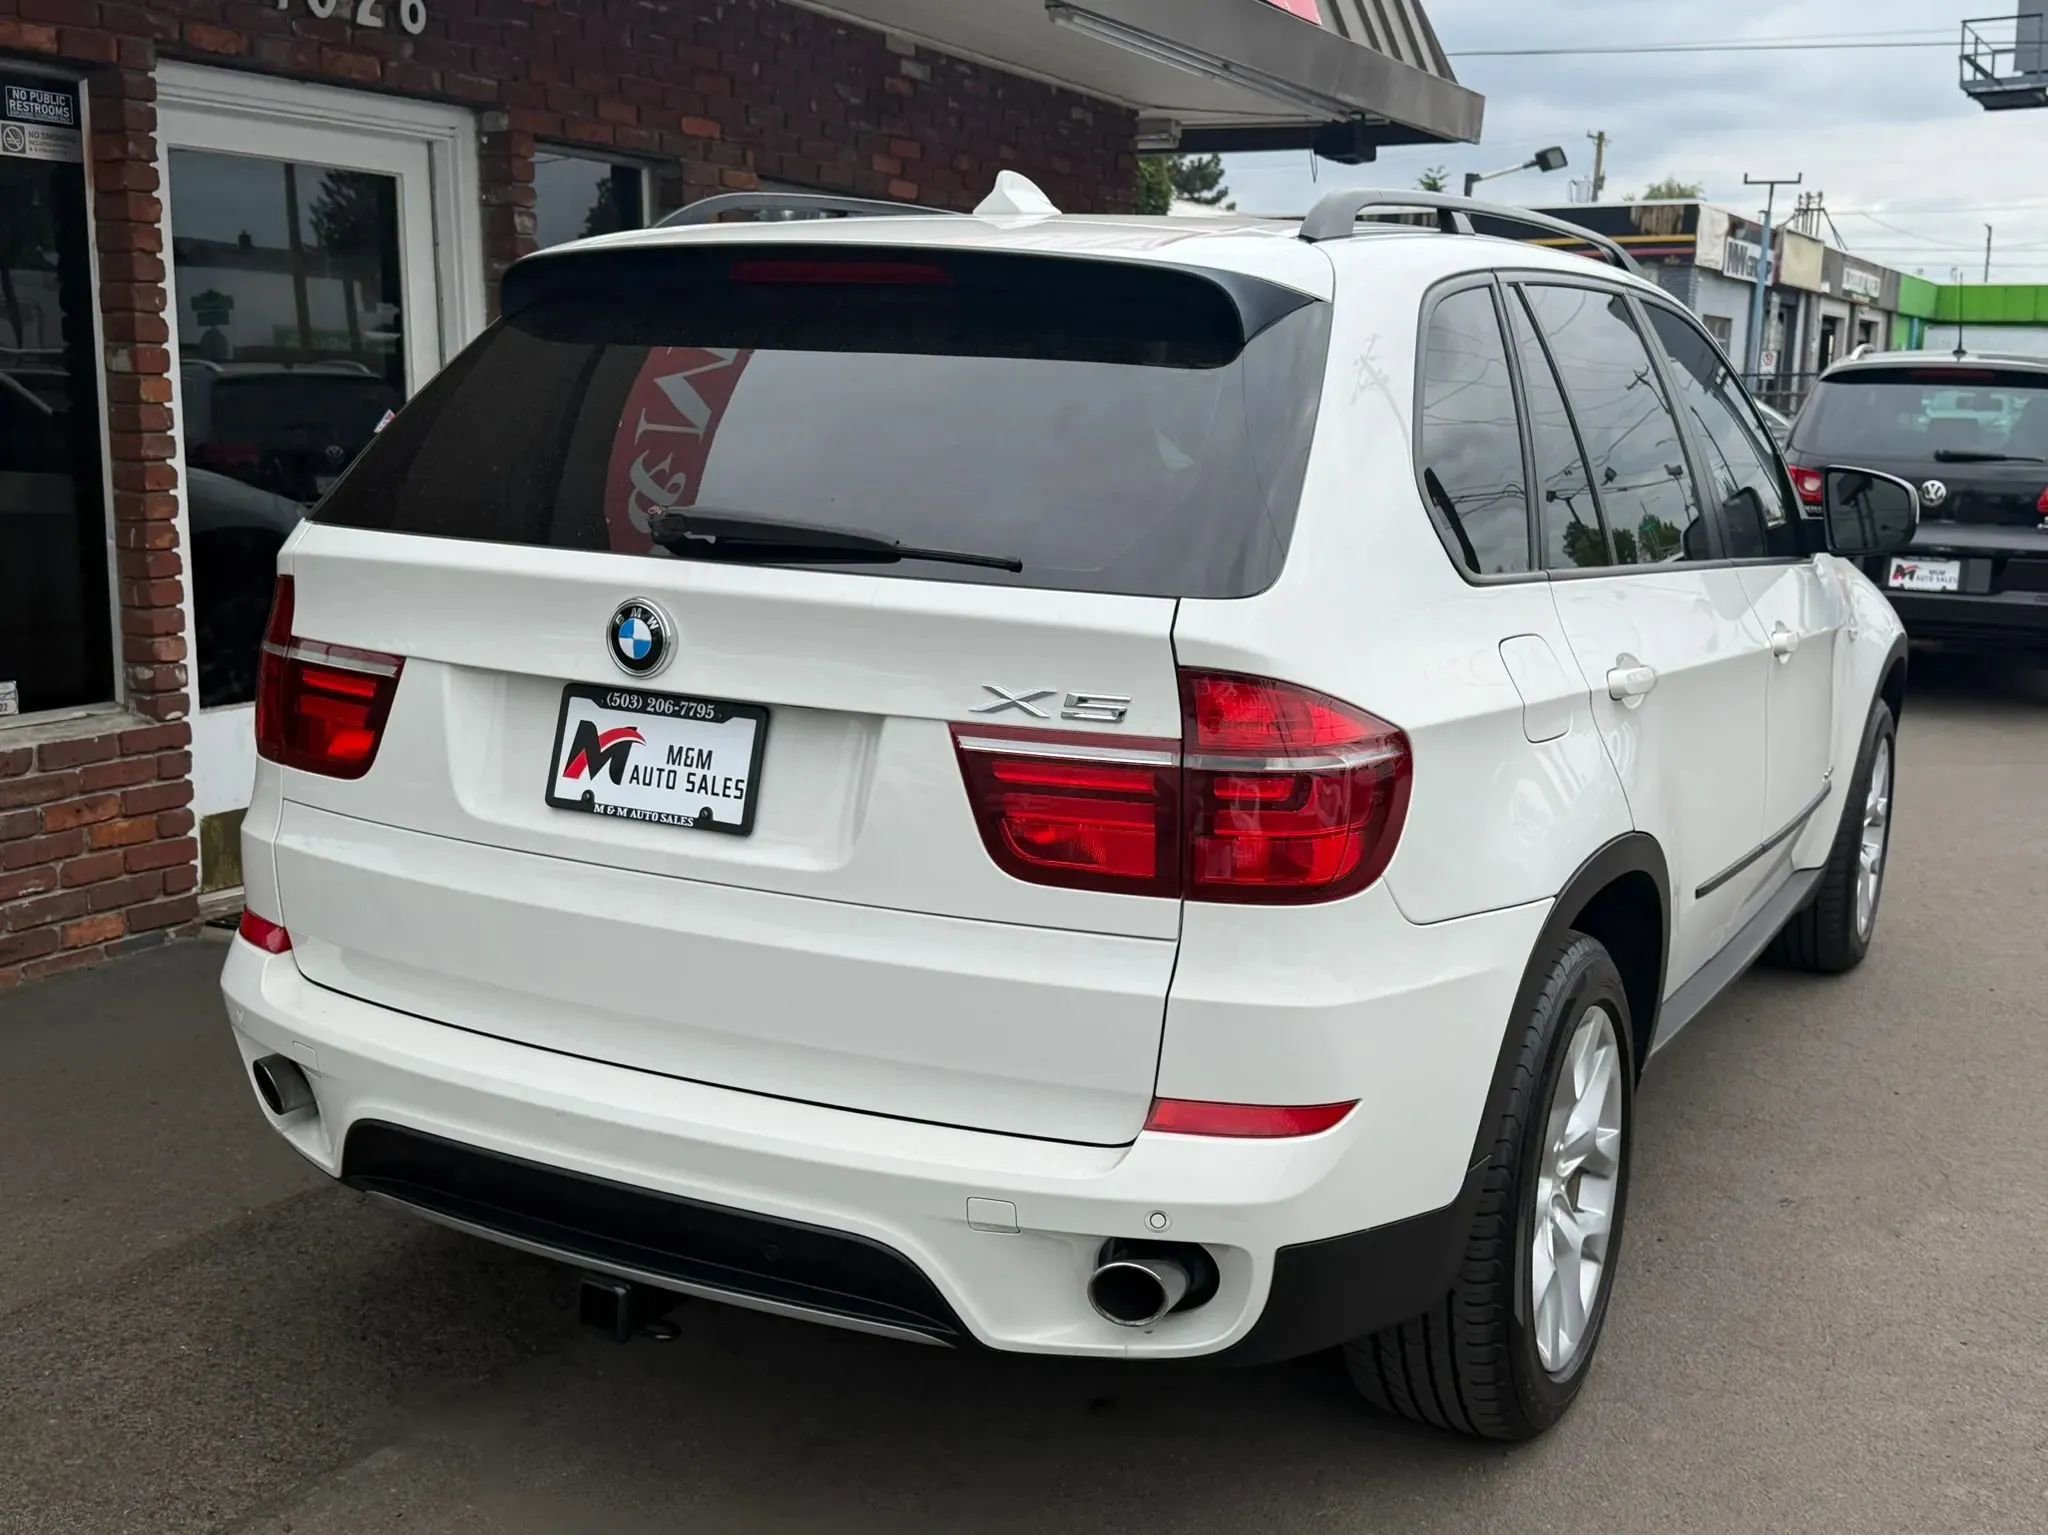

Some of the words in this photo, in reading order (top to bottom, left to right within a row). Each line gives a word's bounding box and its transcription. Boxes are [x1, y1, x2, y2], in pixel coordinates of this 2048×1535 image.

[9, 99, 70, 117] RESTROOMS
[12, 90, 27, 100] NO
[30, 91, 66, 106] PUBLIC
[28, 129, 40, 139] NO
[1916, 575, 1934, 583] AUTO
[1936, 576, 1958, 584] SALES
[616, 607, 660, 630] BMW
[606, 691, 643, 710] (503)
[647, 697, 716, 719] 206-7795
[968, 684, 1132, 724] X5
[666, 744, 714, 771] M&M
[628, 764, 678, 791] AUTO
[685, 772, 746, 801] SALES
[593, 803, 606, 814] M
[606, 805, 616, 816] &
[617, 808, 629, 818] M
[629, 810, 659, 821] AUTO
[660, 813, 695, 827] SALES
